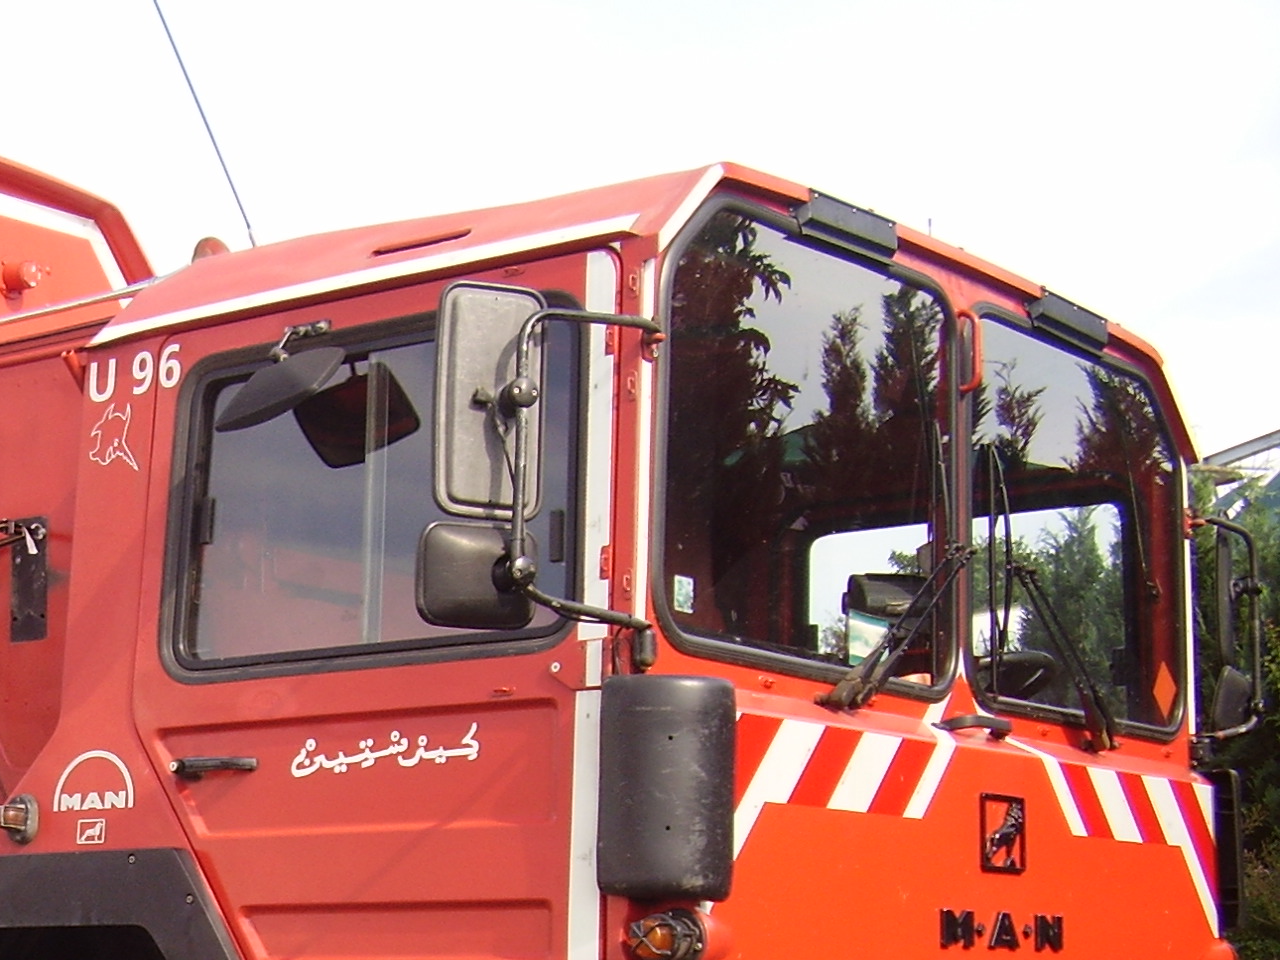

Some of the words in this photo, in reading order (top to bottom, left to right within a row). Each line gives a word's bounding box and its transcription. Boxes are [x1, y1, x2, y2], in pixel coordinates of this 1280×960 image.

[89, 358, 117, 402] U
[132, 343, 182, 395] 96
[60, 790, 127, 812] MAN
